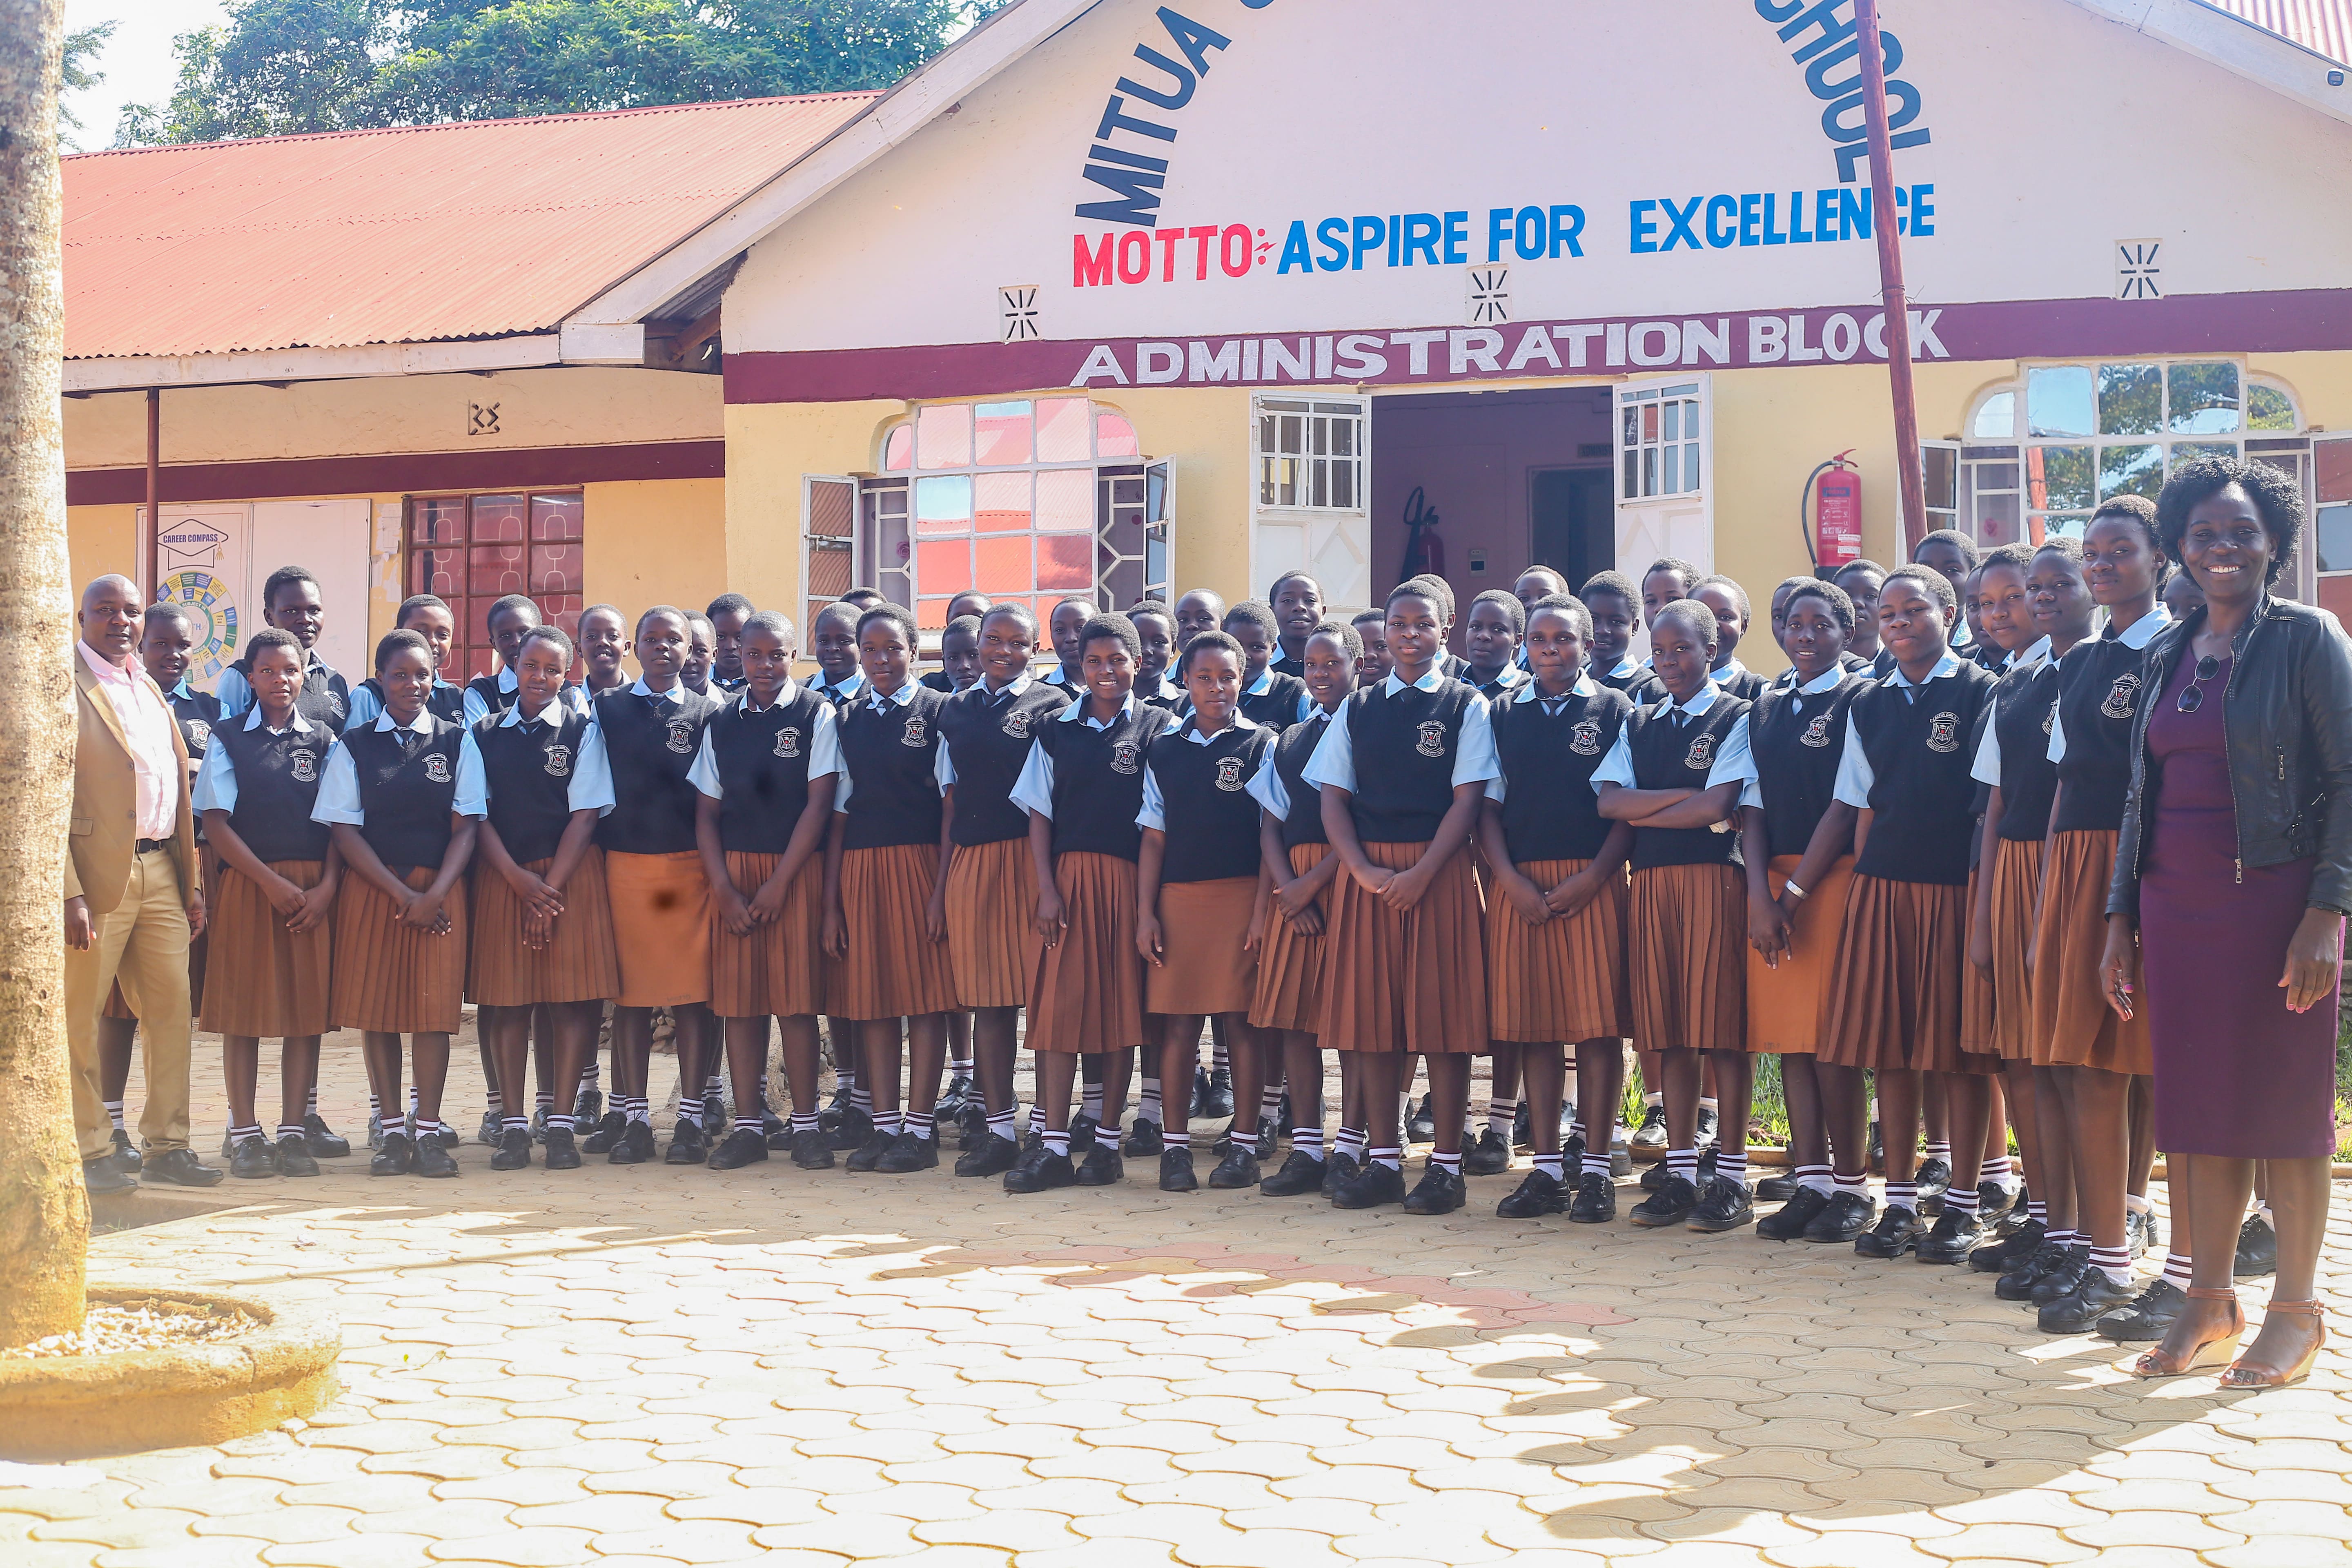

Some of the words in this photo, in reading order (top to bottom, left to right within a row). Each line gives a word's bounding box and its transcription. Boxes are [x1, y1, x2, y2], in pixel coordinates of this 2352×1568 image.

[1075, 5, 1232, 227] MITUA
[1754, 0, 1931, 183] HOOL
[1276, 211, 1468, 275] ASPIRE
[1488, 204, 1586, 262] FOR
[1069, 318, 1731, 387] ADMINISTRATION
[1748, 308, 1951, 363] BLOCK
[163, 535, 187, 543] CAREER
[187, 534, 218, 543] COMPASS
[193, 644, 206, 654] HOIC
